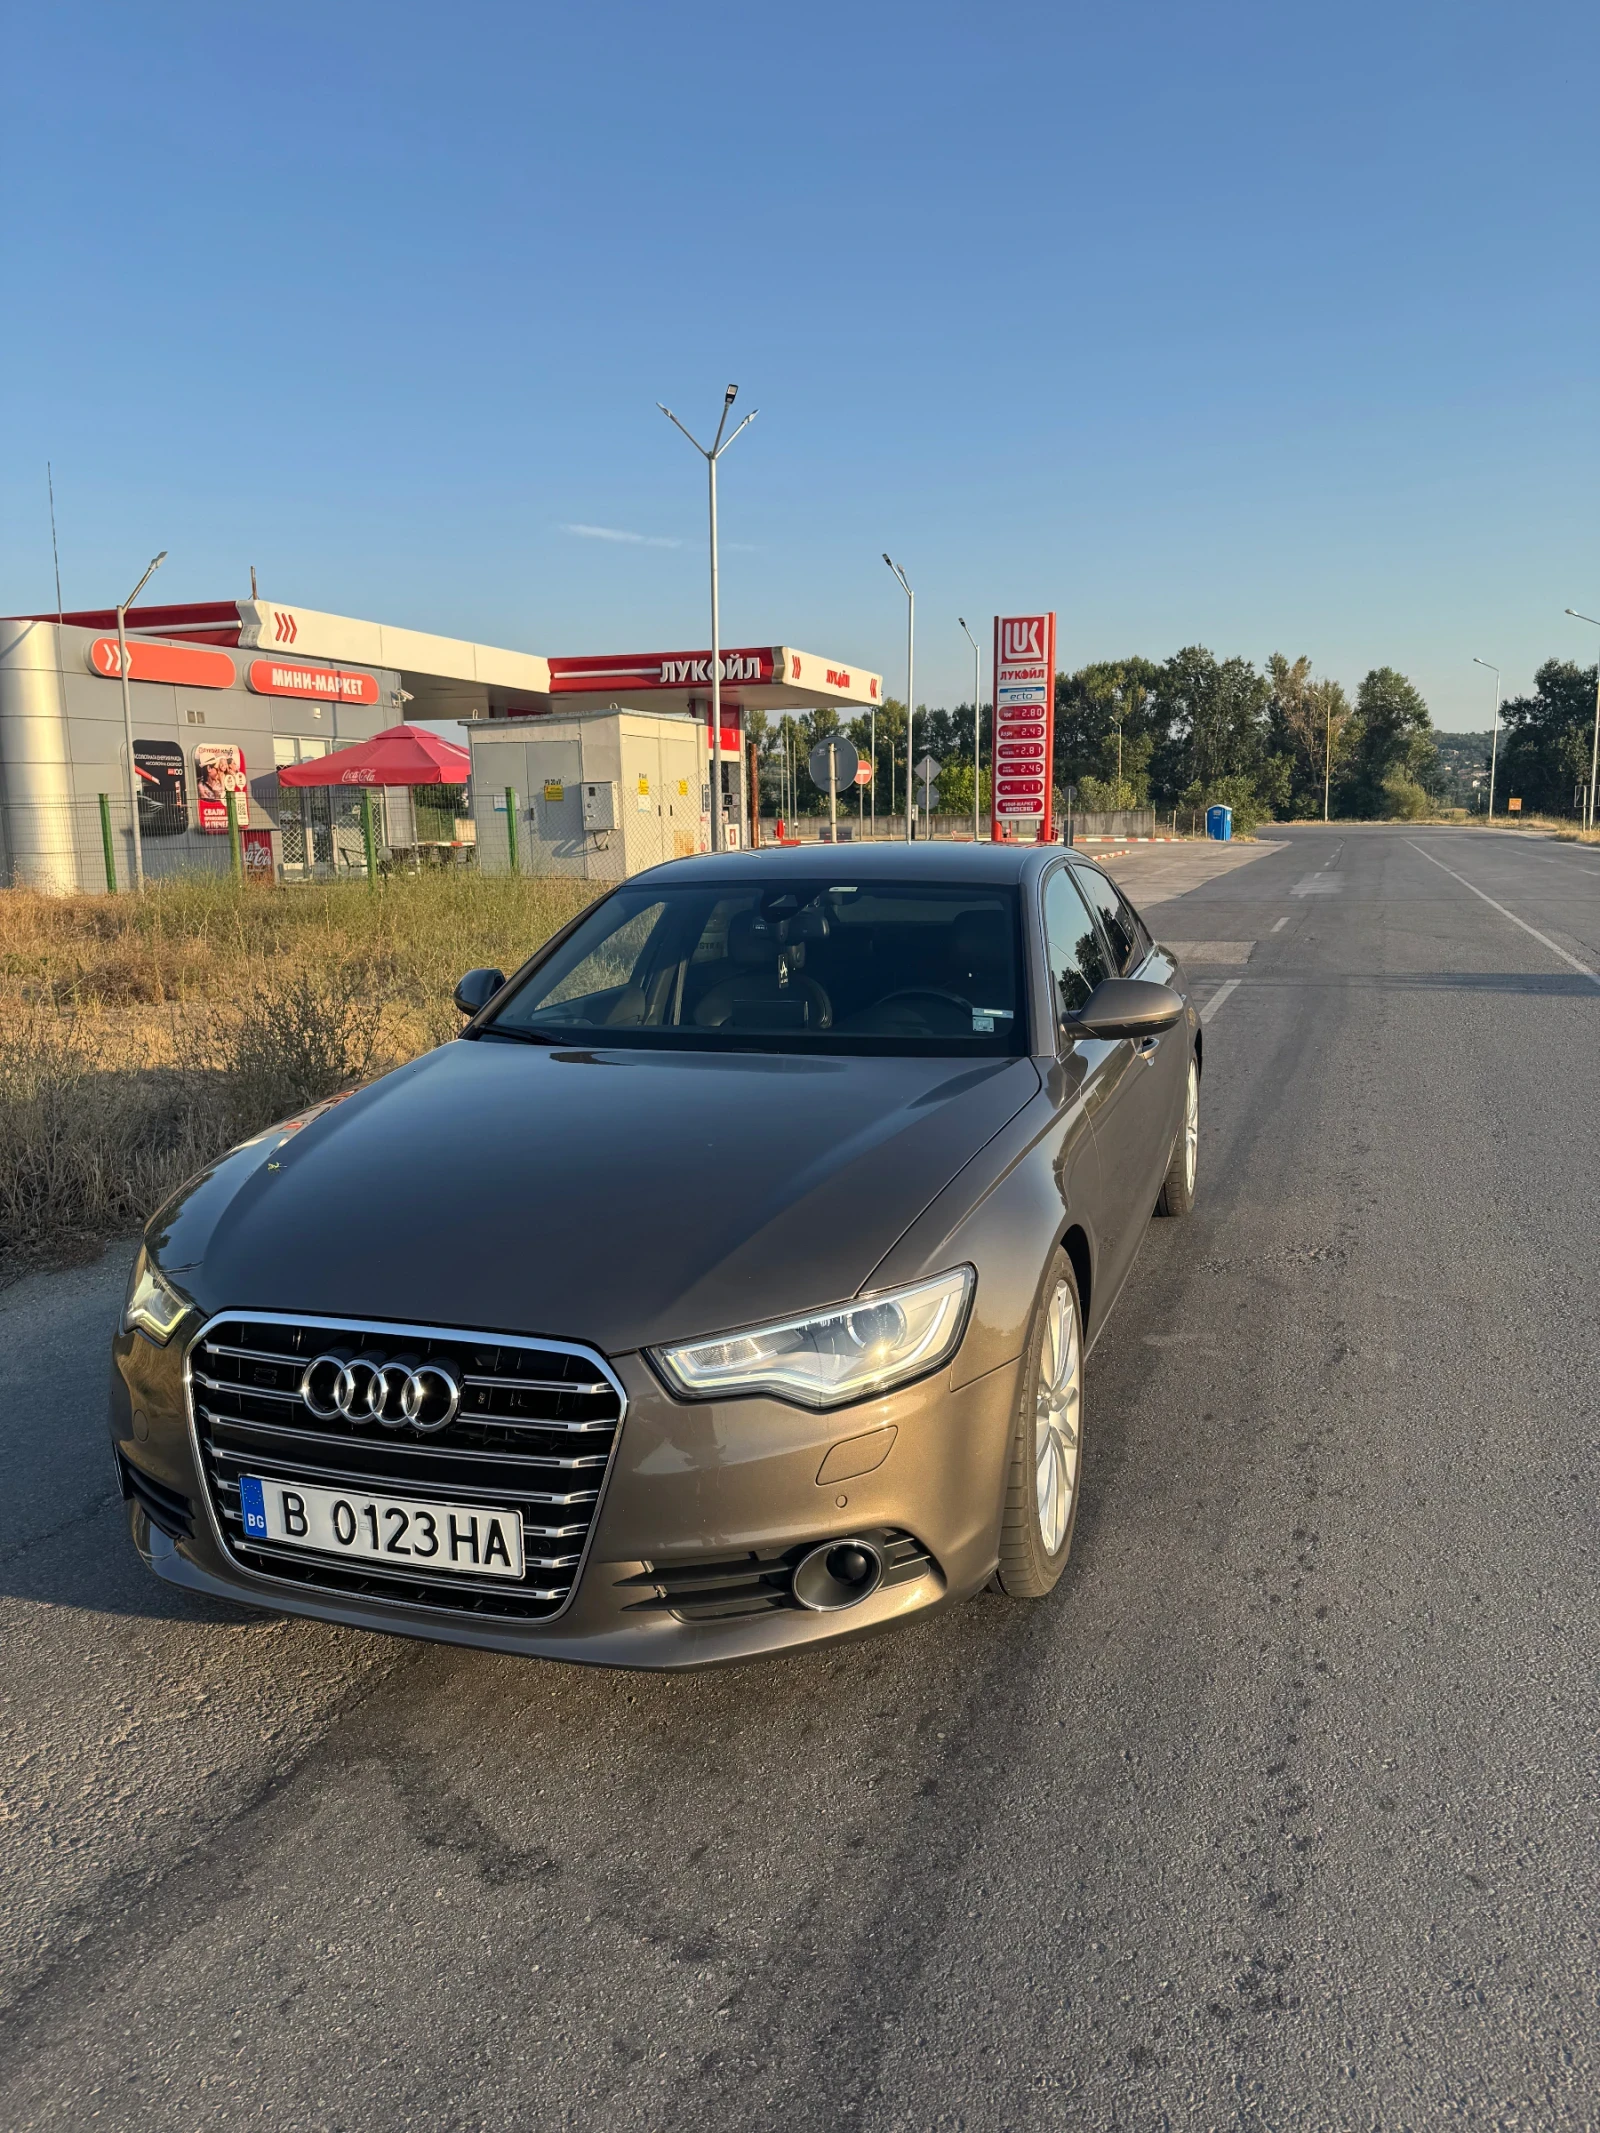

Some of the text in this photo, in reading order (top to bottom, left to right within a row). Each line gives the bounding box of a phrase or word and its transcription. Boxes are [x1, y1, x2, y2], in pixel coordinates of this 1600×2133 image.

[660, 653, 761, 683] ЛУКОЙЛ
[1000, 667, 1045, 681] ЛУКОЙЛ
[272, 668, 363, 696] МИНИ-МАРКЕТ
[1010, 692, 1033, 701] ecto
[1021, 708, 1042, 717] 2.80
[1021, 727, 1042, 736] 2.43
[1020, 746, 1041, 755] 2.81
[1020, 764, 1041, 773] 2.46
[1022, 783, 1041, 792] 1.11
[247, 1513, 264, 1529] BG
[282, 1491, 512, 1568] B 0123 HA
